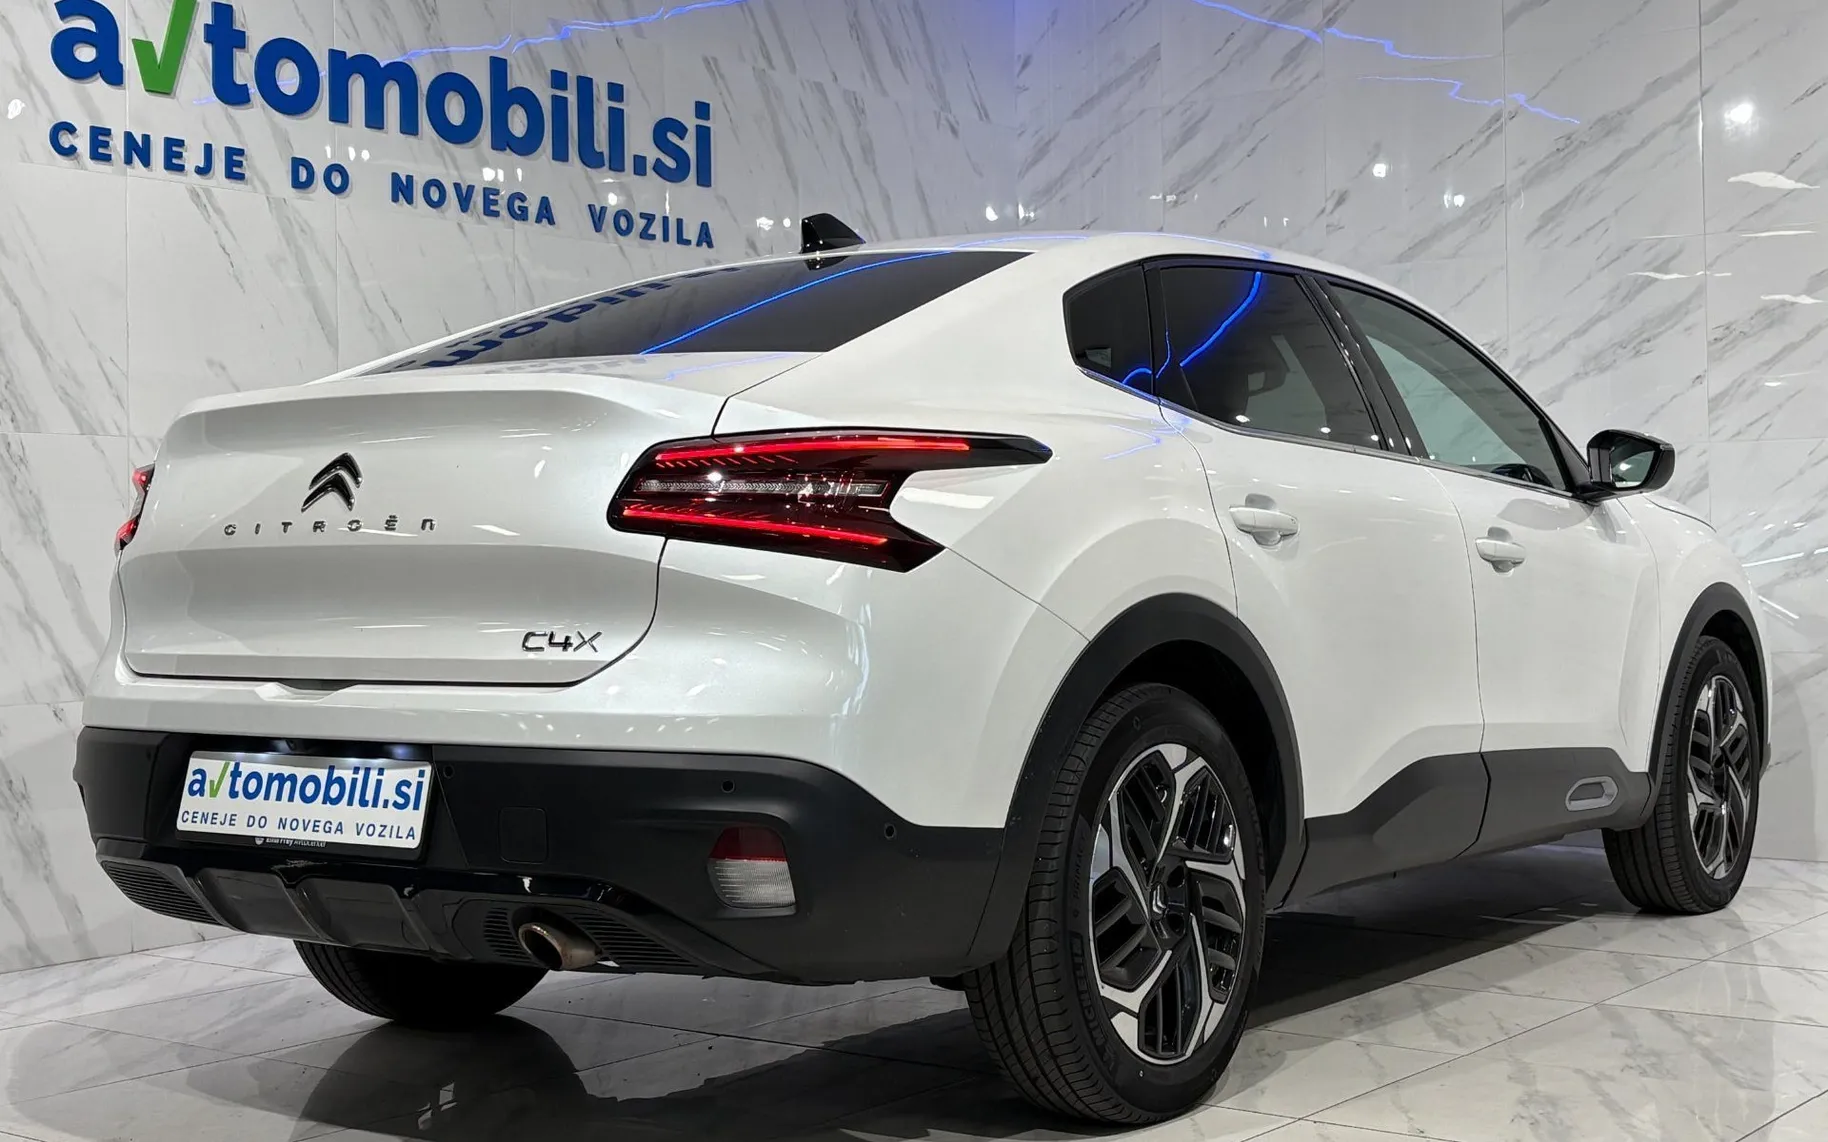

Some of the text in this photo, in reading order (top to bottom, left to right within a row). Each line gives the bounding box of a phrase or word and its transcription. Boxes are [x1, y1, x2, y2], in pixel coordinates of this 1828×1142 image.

[49, 121, 714, 249] CENEJE DO NOVEGA VOZILA
[521, 630, 602, 653] C4X
[181, 810, 416, 840] CENEJE DO NOVEGA VOZILA
